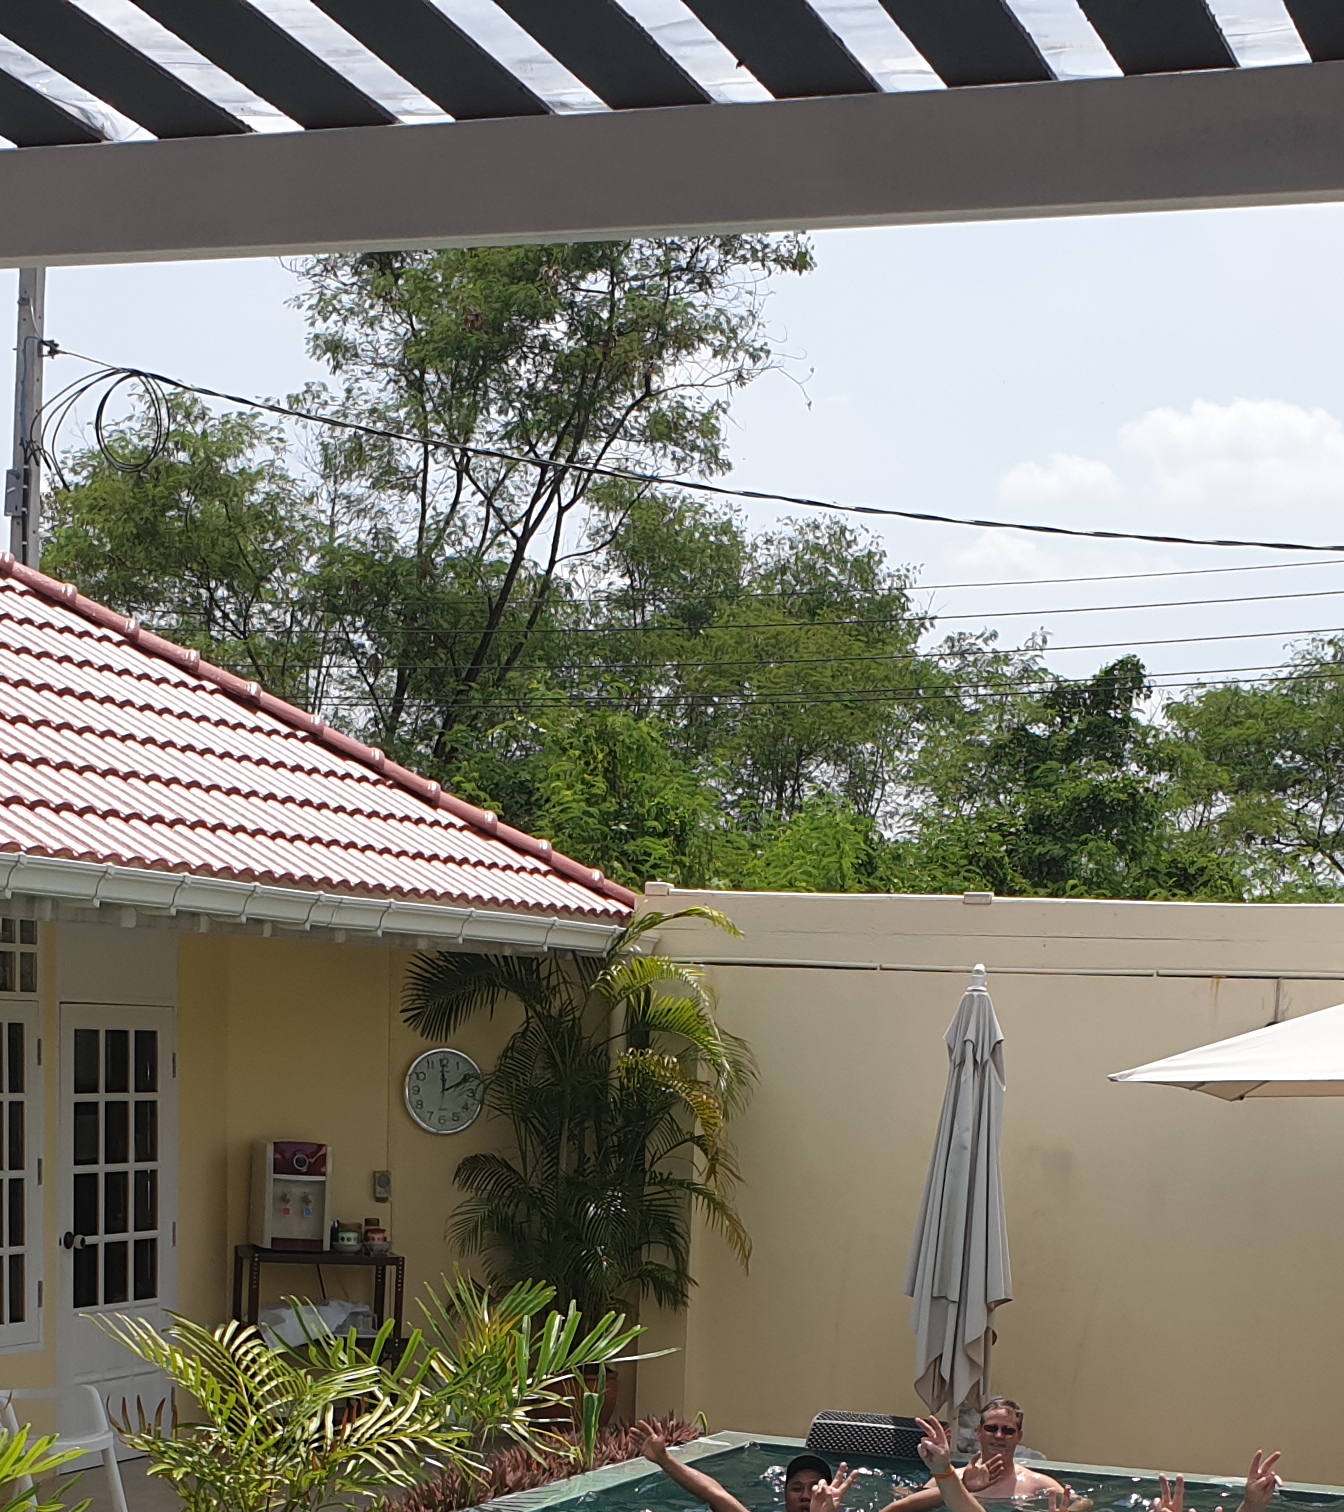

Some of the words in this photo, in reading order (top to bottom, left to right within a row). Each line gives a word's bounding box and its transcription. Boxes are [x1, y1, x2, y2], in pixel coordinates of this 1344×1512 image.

[426, 1059, 435, 1070] 11
[415, 1071, 426, 1082] 10
[412, 1085, 420, 1095] 9
[466, 1088, 475, 1098] 3
[416, 1100, 424, 1110] 8
[461, 1103, 469, 1112] 4
[427, 1111, 434, 1121] 7
[438, 1115, 446, 1125] 6
[452, 1112, 460, 1122] 5
